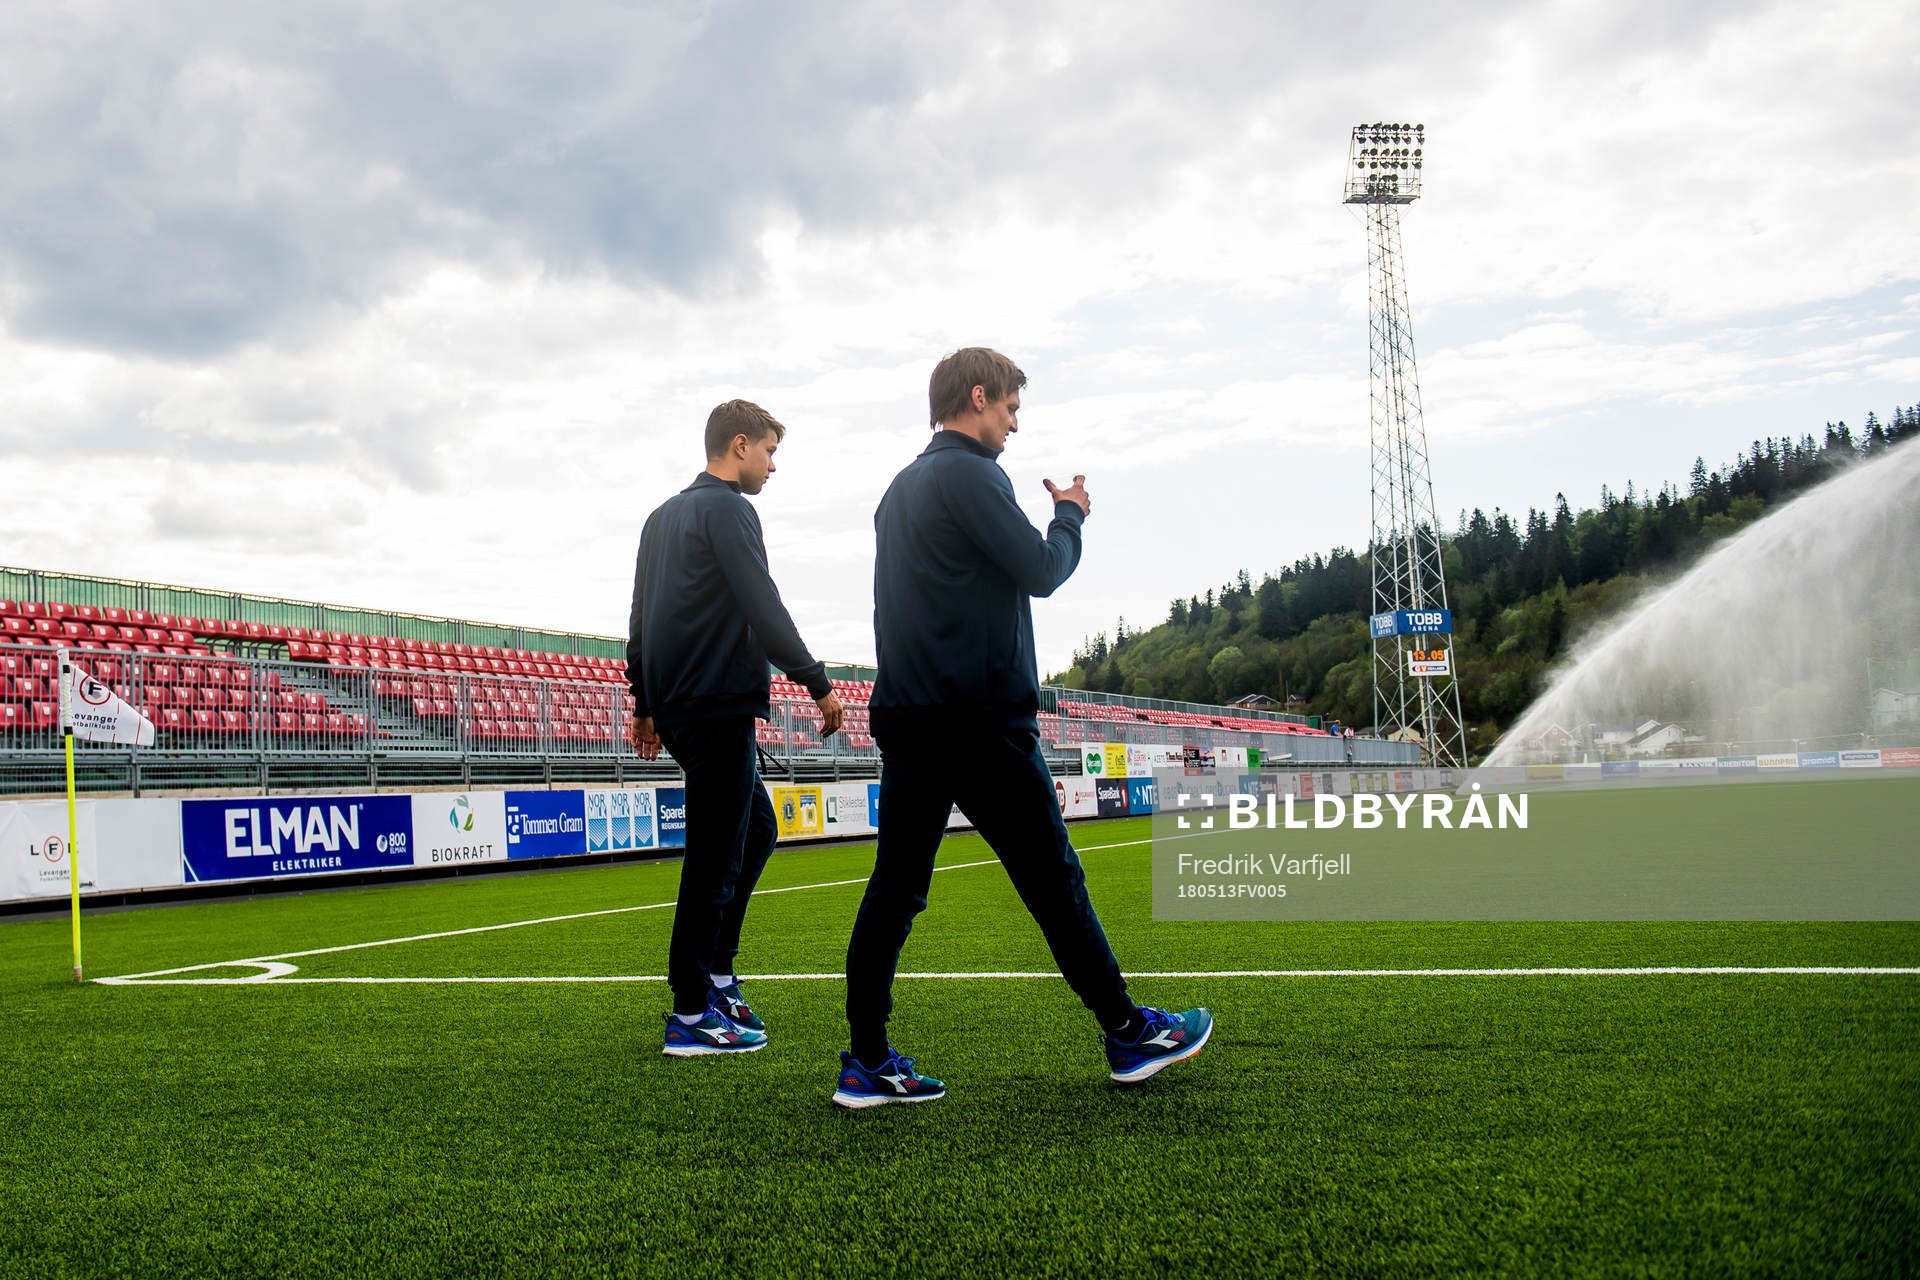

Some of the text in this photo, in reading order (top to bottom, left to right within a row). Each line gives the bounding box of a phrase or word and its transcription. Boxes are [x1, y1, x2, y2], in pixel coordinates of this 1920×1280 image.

[1375, 616, 1392, 629] TOBB
[1406, 613, 1443, 625] TOBB
[1413, 650, 1444, 660] 13.05
[72, 712, 118, 724] evanger
[73, 721, 116, 731] otballklubb
[588, 793, 606, 808] NOR
[611, 792, 629, 806] NOR
[634, 791, 651, 806] NOR
[1097, 786, 1121, 802] SpareBank
[1142, 784, 1159, 806] NTE
[225, 804, 360, 858] ELMAN
[520, 812, 583, 835] Tommen Gram
[389, 832, 407, 847] 800
[432, 844, 493, 863] BIOKRAFT
[273, 856, 342, 871] ELEKTRIKER
